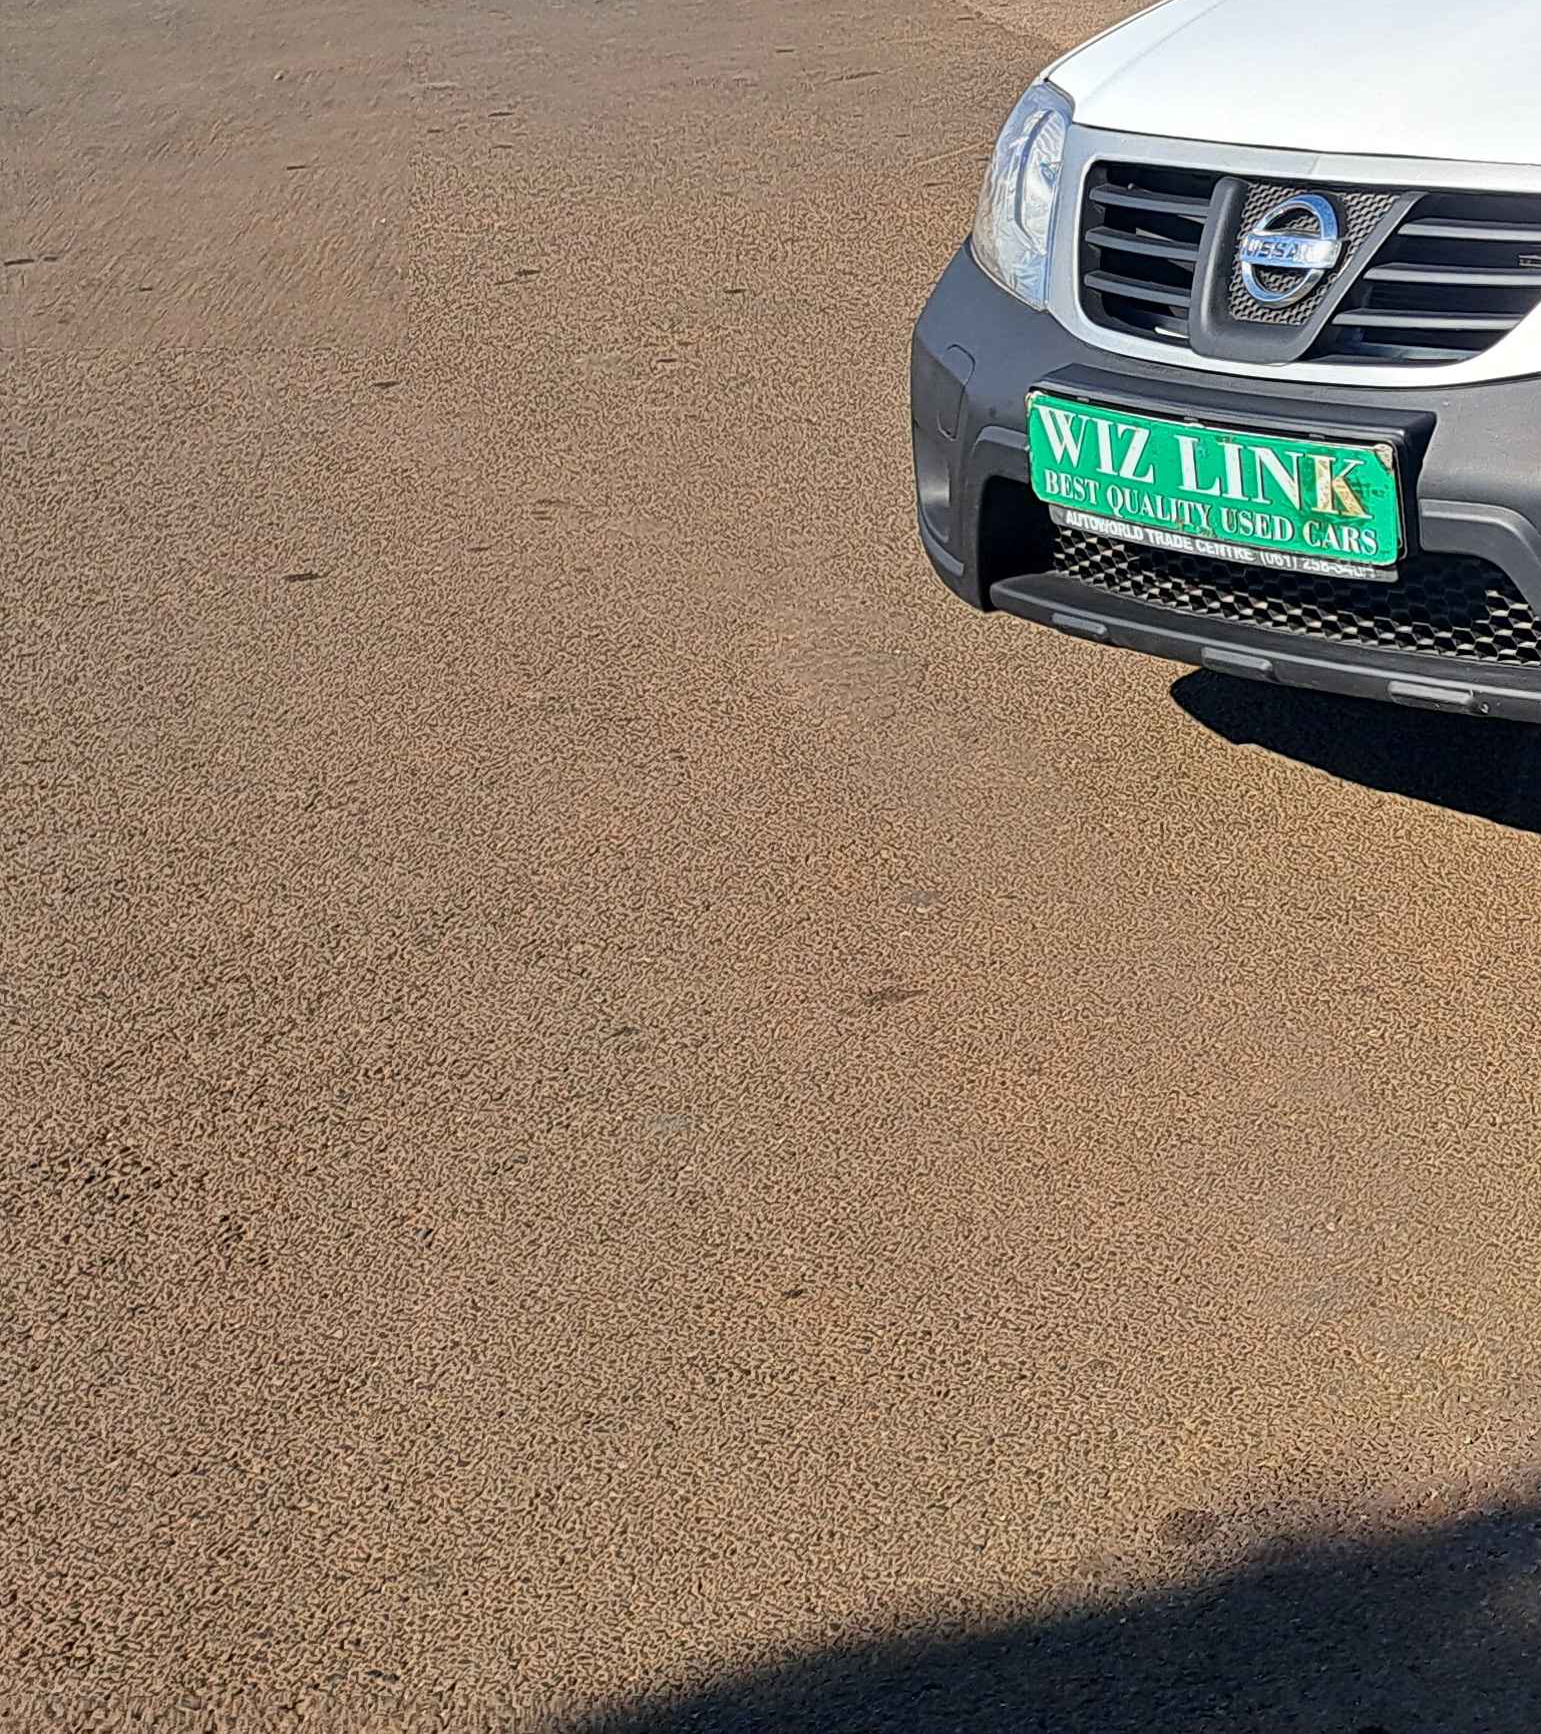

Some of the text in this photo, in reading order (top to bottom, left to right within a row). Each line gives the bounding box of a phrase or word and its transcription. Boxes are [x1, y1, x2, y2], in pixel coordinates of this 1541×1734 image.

[1243, 239, 1314, 263] NISSAN
[1034, 403, 1373, 521] WIZ LINK
[1042, 468, 1379, 556] BEST QUALITY USED CARS
[1065, 509, 1144, 542] AUTOWORLD
[1147, 526, 1195, 553] TRADE
[1195, 538, 1257, 563] CENTRE
